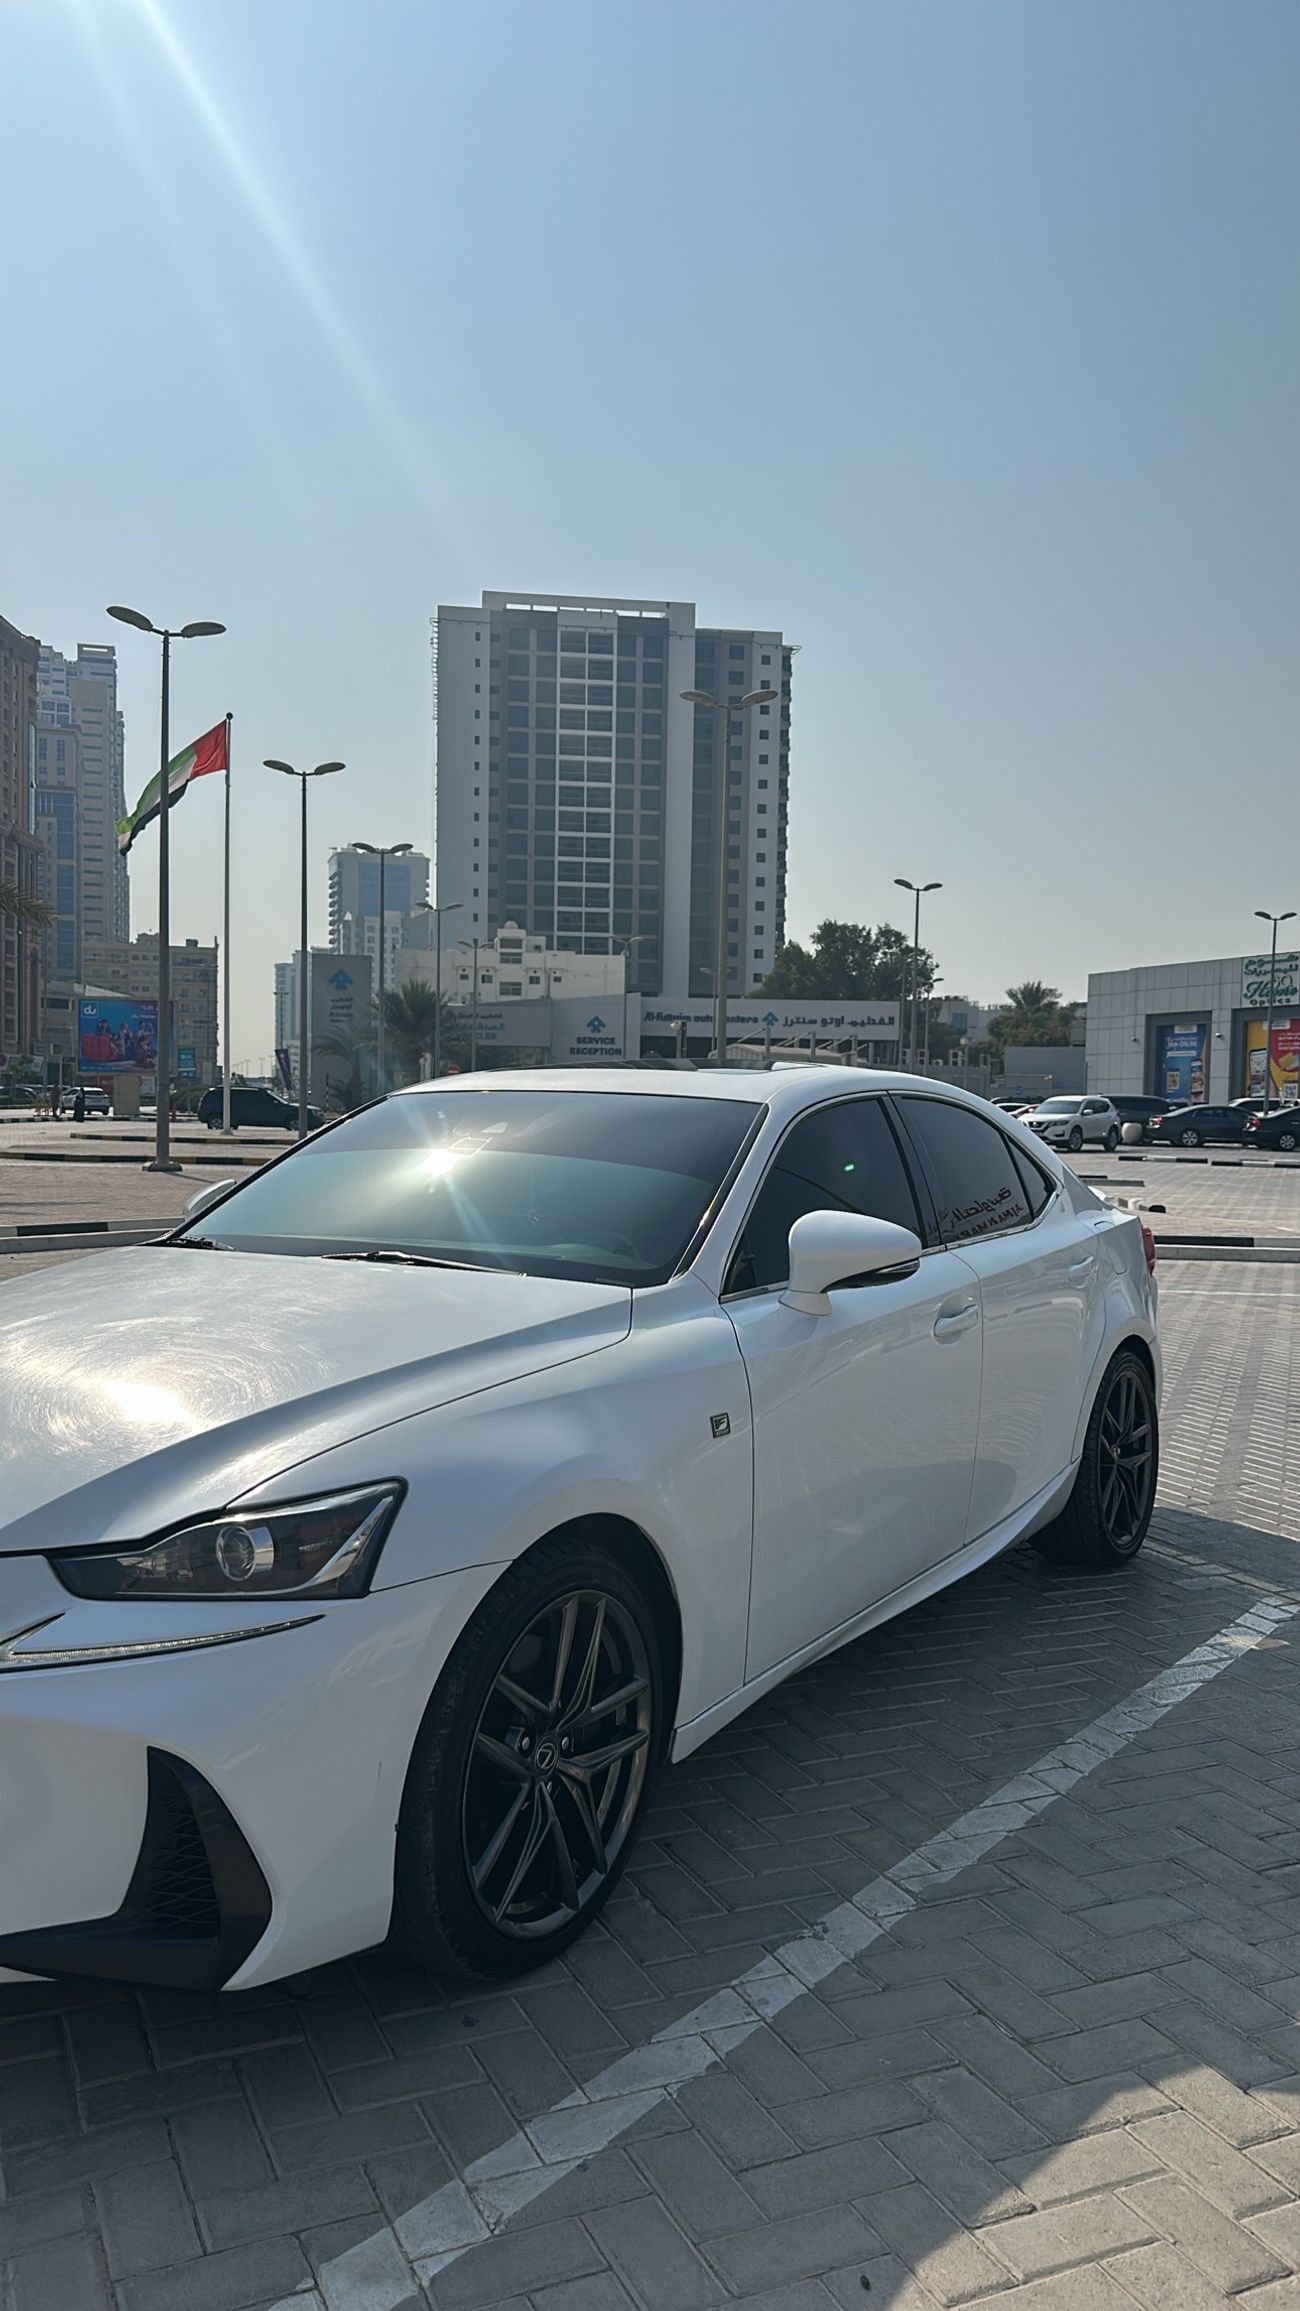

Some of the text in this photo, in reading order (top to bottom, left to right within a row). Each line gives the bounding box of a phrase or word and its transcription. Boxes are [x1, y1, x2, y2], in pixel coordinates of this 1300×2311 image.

[1244, 981, 1298, 999] Home
[83, 1004, 96, 1015] du
[726, 1014, 758, 1024] enters
[782, 1015, 817, 1027] سنترز
[847, 1014, 895, 1026] الفطيم
[576, 1036, 616, 1045] SERVICE
[569, 1047, 622, 1056] RECEPTION
